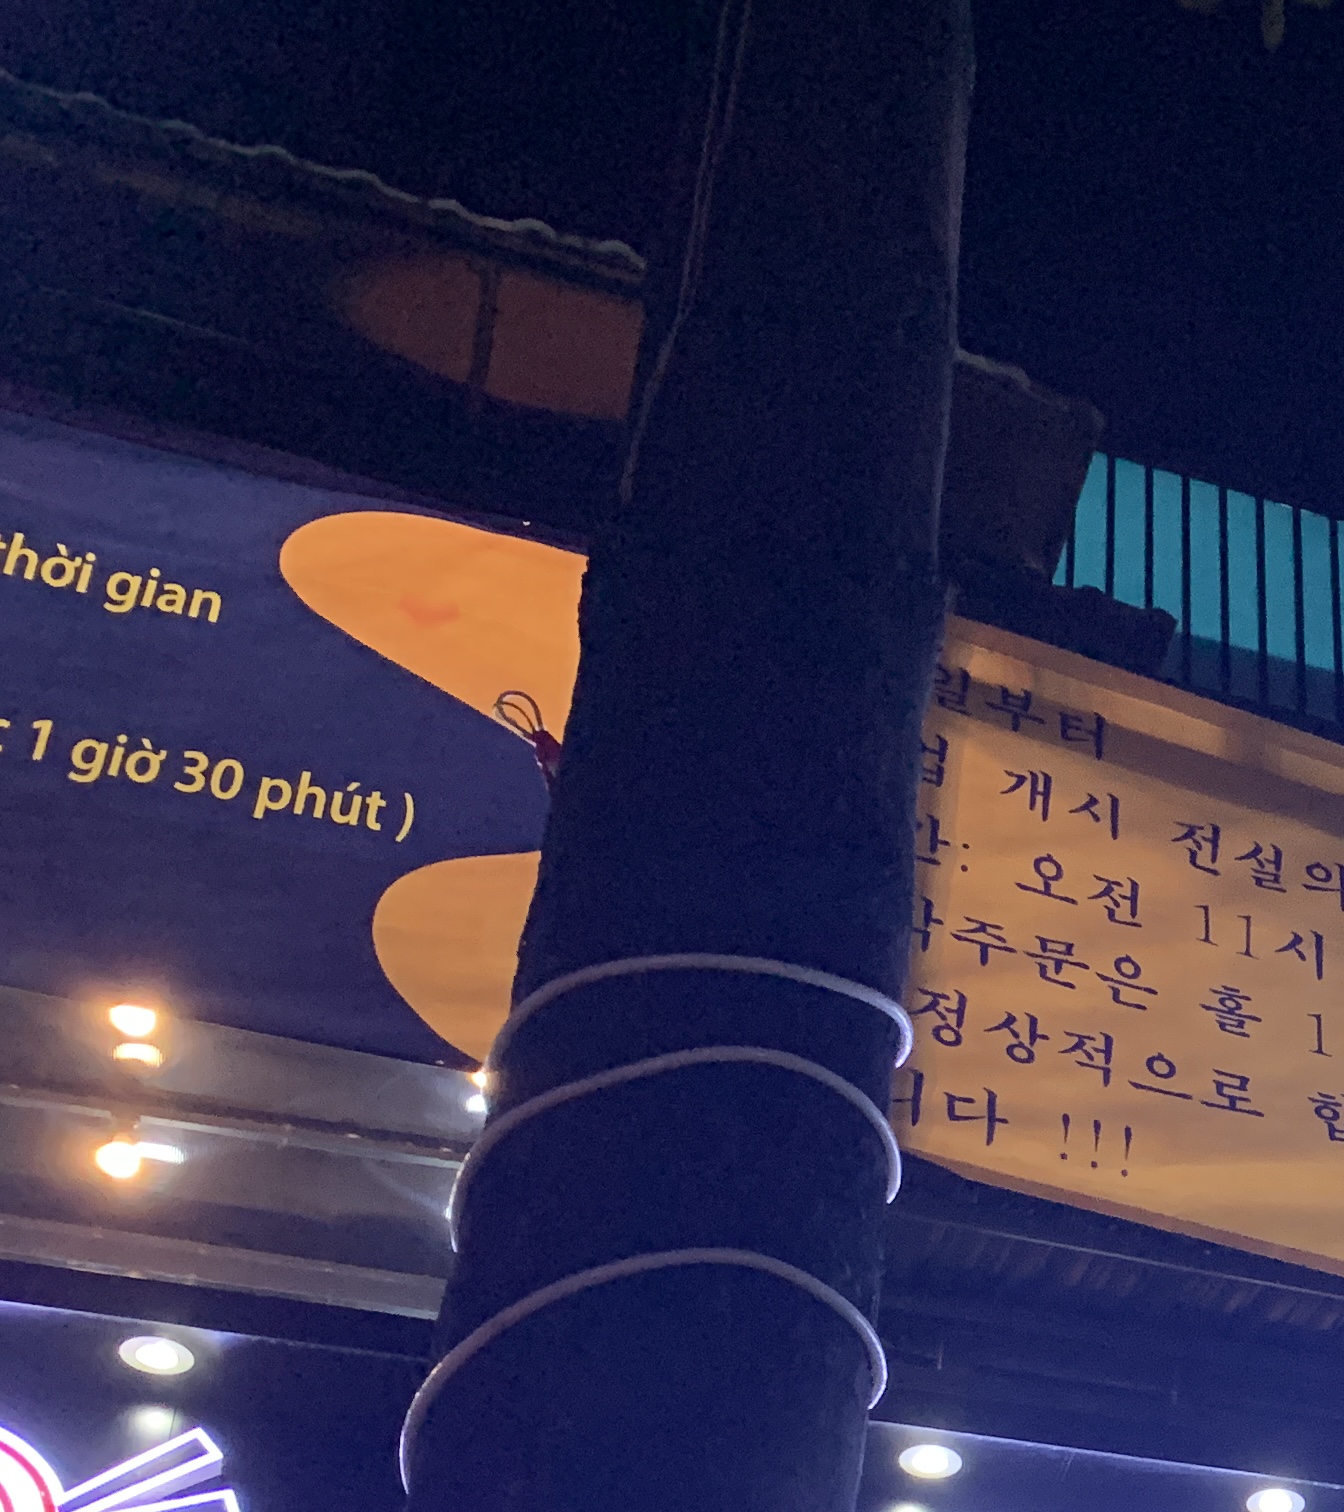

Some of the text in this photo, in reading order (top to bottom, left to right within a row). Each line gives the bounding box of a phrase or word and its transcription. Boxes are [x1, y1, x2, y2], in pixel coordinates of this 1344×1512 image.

[104, 568, 222, 623] gian
[31, 719, 54, 761] 1
[68, 734, 168, 783] giờ
[173, 750, 245, 800] 30
[252, 770, 387, 832] phút
[1000, 768, 1122, 840] 개시
[1016, 852, 1141, 929] 오전
[1200, 983, 1262, 1039] 홀
[909, 987, 1265, 1118] 정상적으로
